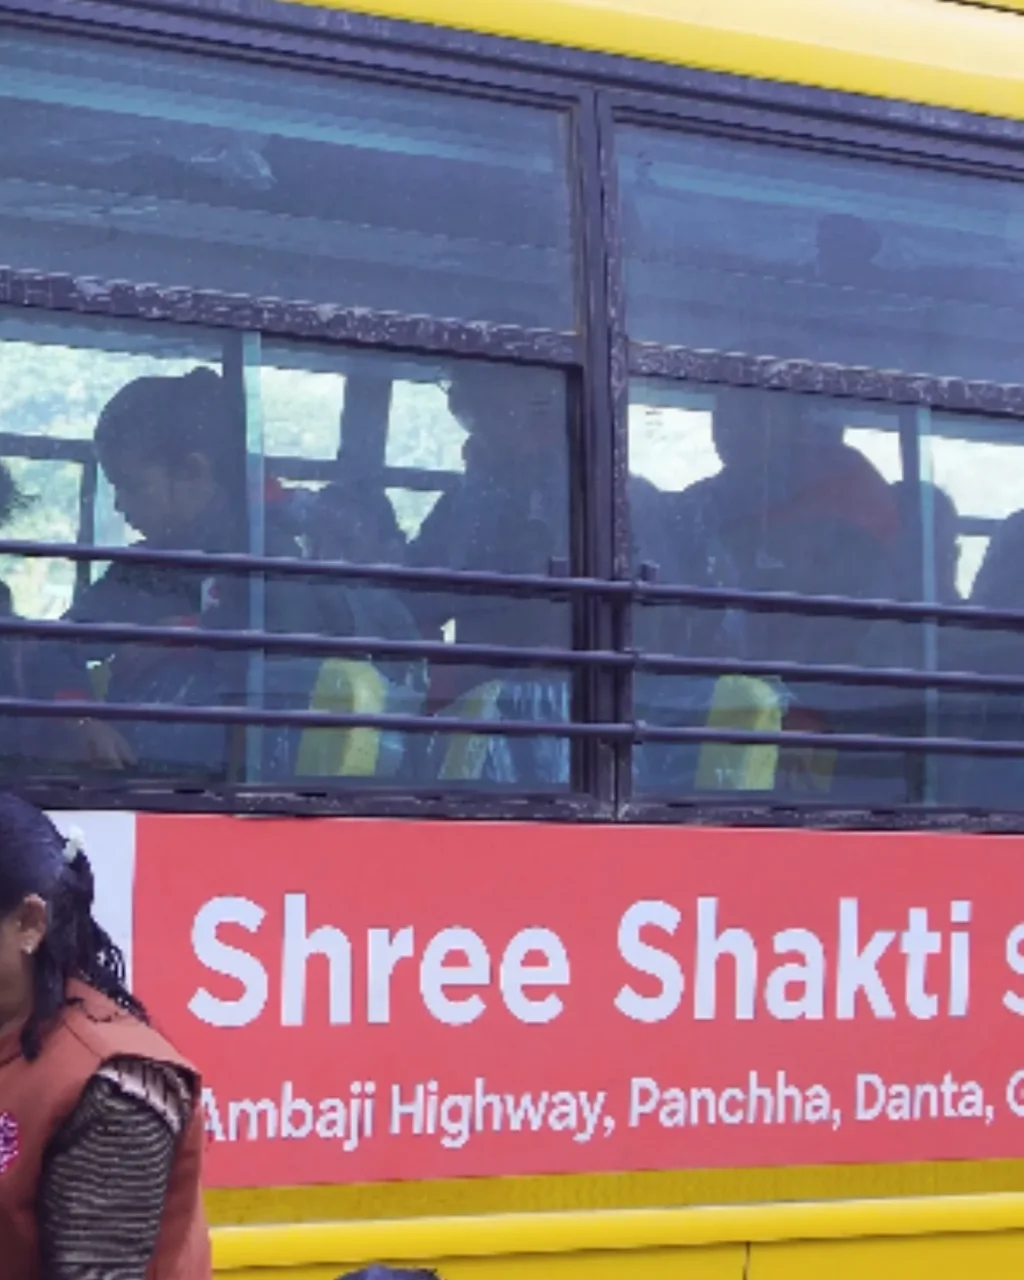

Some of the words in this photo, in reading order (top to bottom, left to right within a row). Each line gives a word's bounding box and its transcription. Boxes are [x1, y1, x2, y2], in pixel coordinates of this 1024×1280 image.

[187, 893, 571, 1028] Shree
[613, 896, 972, 1024] Shakti
[200, 1080, 377, 1152] Ambaji
[389, 1076, 616, 1149] Highway,
[628, 1069, 842, 1131] Panchha,
[854, 1071, 995, 1125] Danta,
